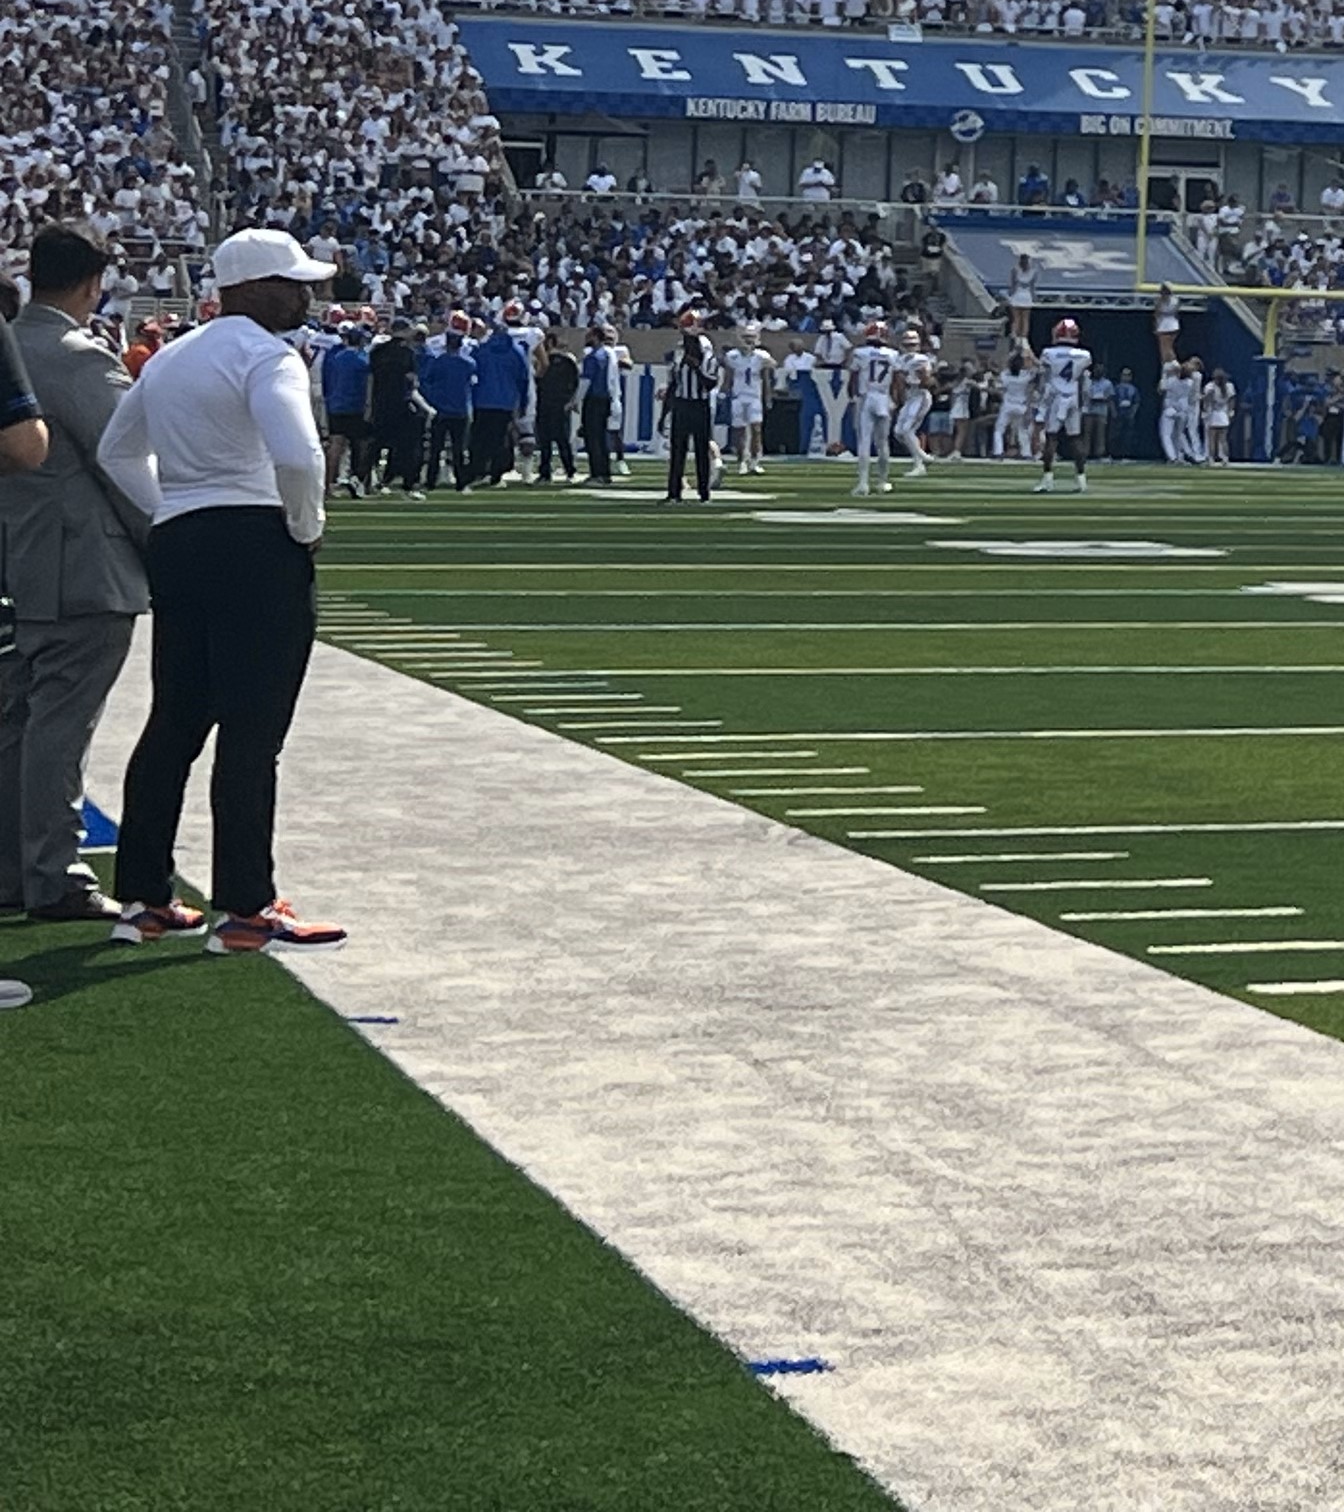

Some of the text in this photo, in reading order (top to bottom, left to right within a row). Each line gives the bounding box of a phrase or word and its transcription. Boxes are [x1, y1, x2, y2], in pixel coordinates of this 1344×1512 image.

[508, 41, 1334, 107] KENTUCKY
[686, 97, 877, 124] KENTUCKY FARM BUREAU
[1109, 116, 1131, 135] ON
